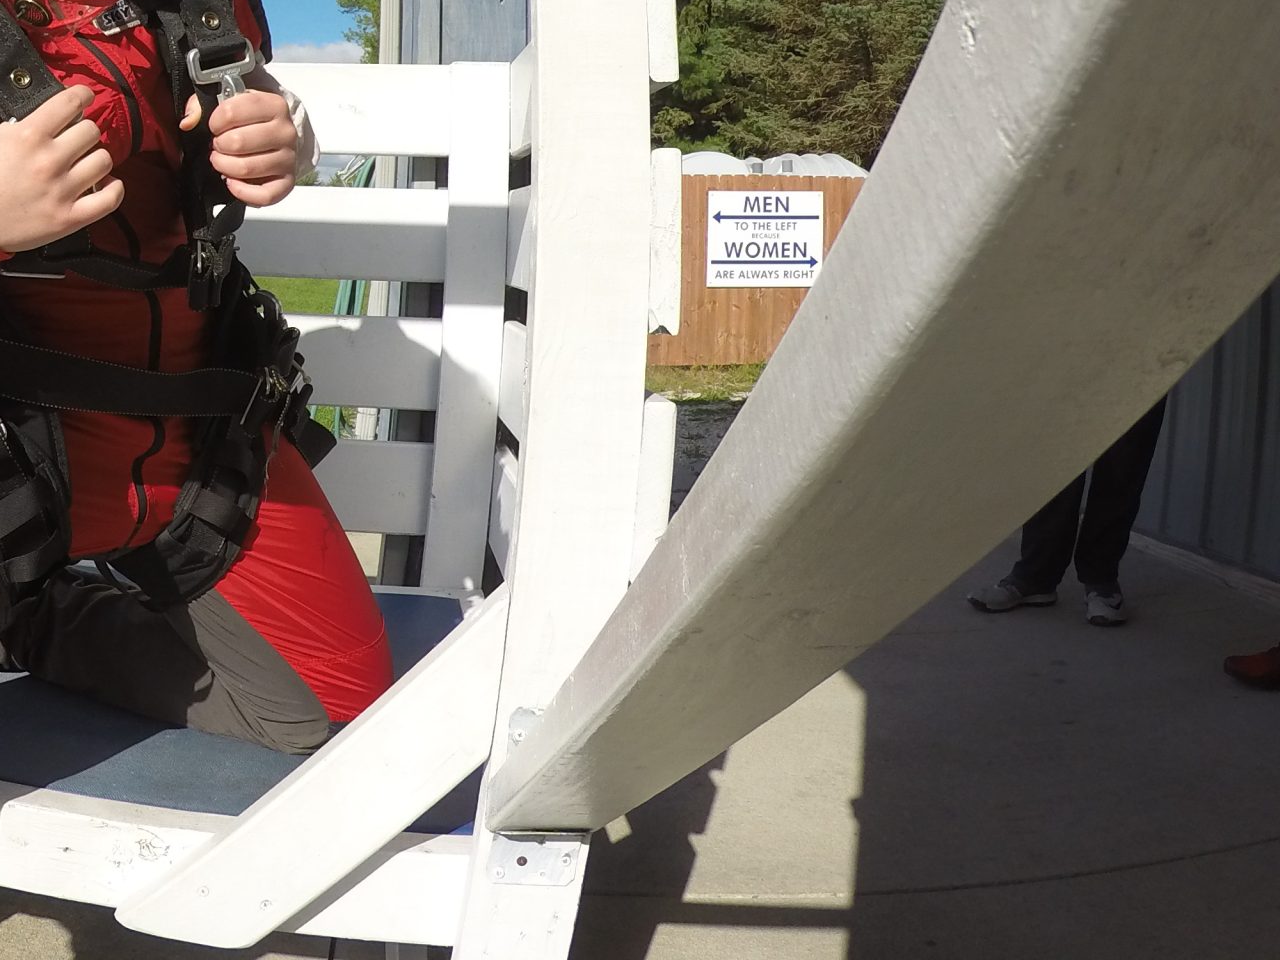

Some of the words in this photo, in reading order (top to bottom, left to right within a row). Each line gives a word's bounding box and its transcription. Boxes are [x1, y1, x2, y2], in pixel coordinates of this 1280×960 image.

[743, 196, 790, 213] MEN
[735, 221, 749, 231] TO
[753, 221, 771, 231] THE
[775, 221, 797, 231] LEFT
[724, 241, 807, 259] WOMEN
[715, 270, 735, 279] ARE
[738, 270, 780, 279] ALWAYS
[783, 270, 815, 279] RIGHT
